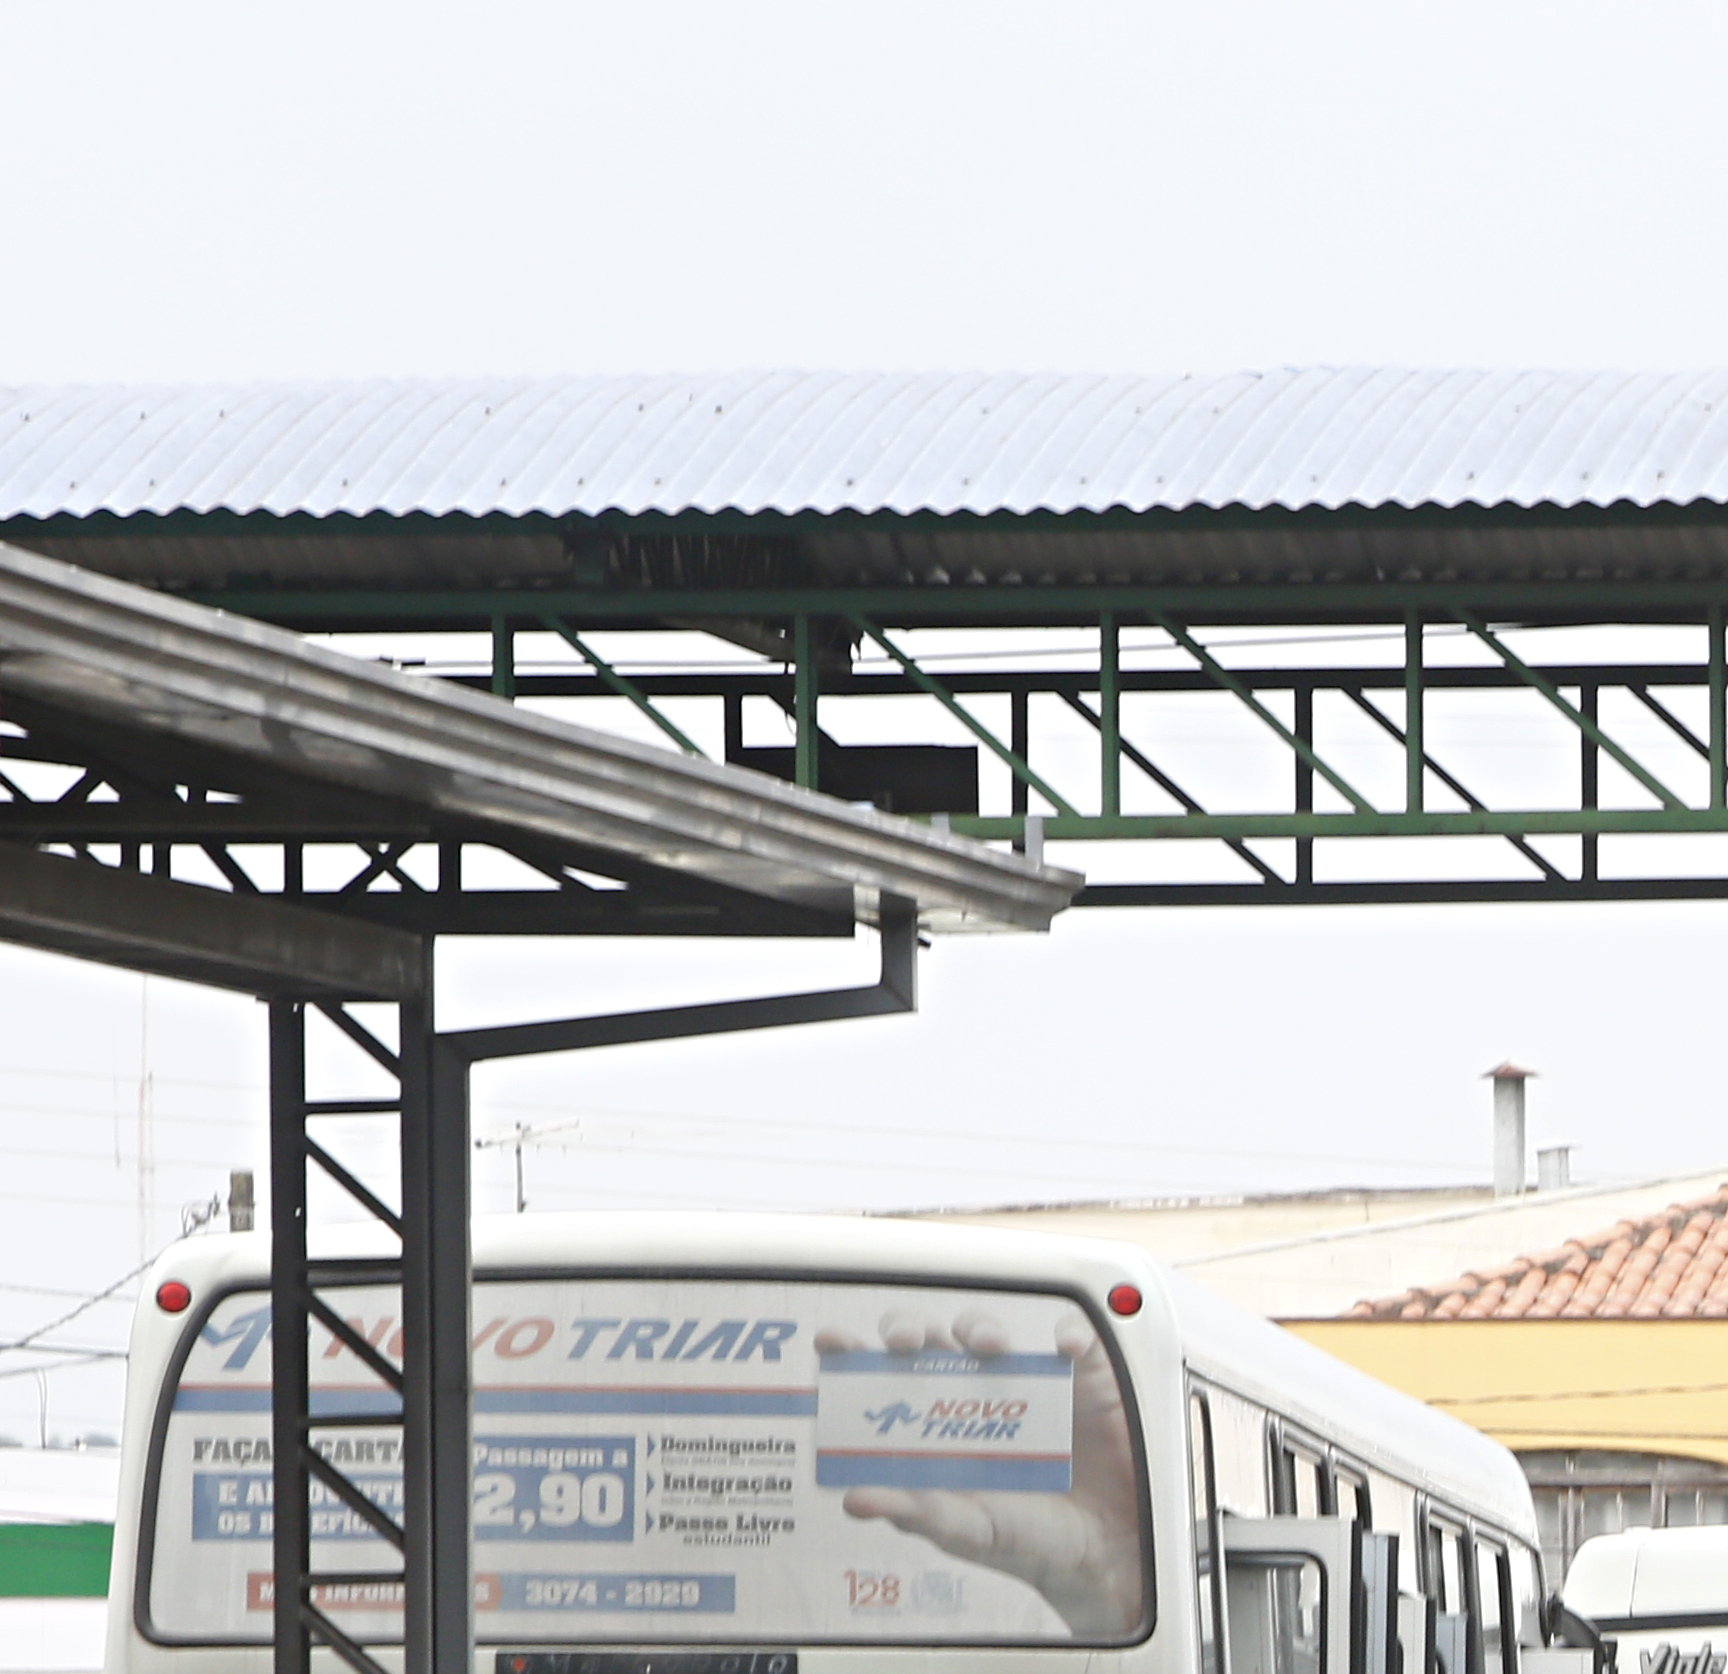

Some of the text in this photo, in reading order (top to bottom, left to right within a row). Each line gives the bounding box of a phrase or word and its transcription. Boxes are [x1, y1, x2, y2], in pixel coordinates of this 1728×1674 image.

[567, 1316, 798, 1362] TRIAR
[929, 1398, 1029, 1420] NOVO
[473, 1473, 624, 1534] 2,90
